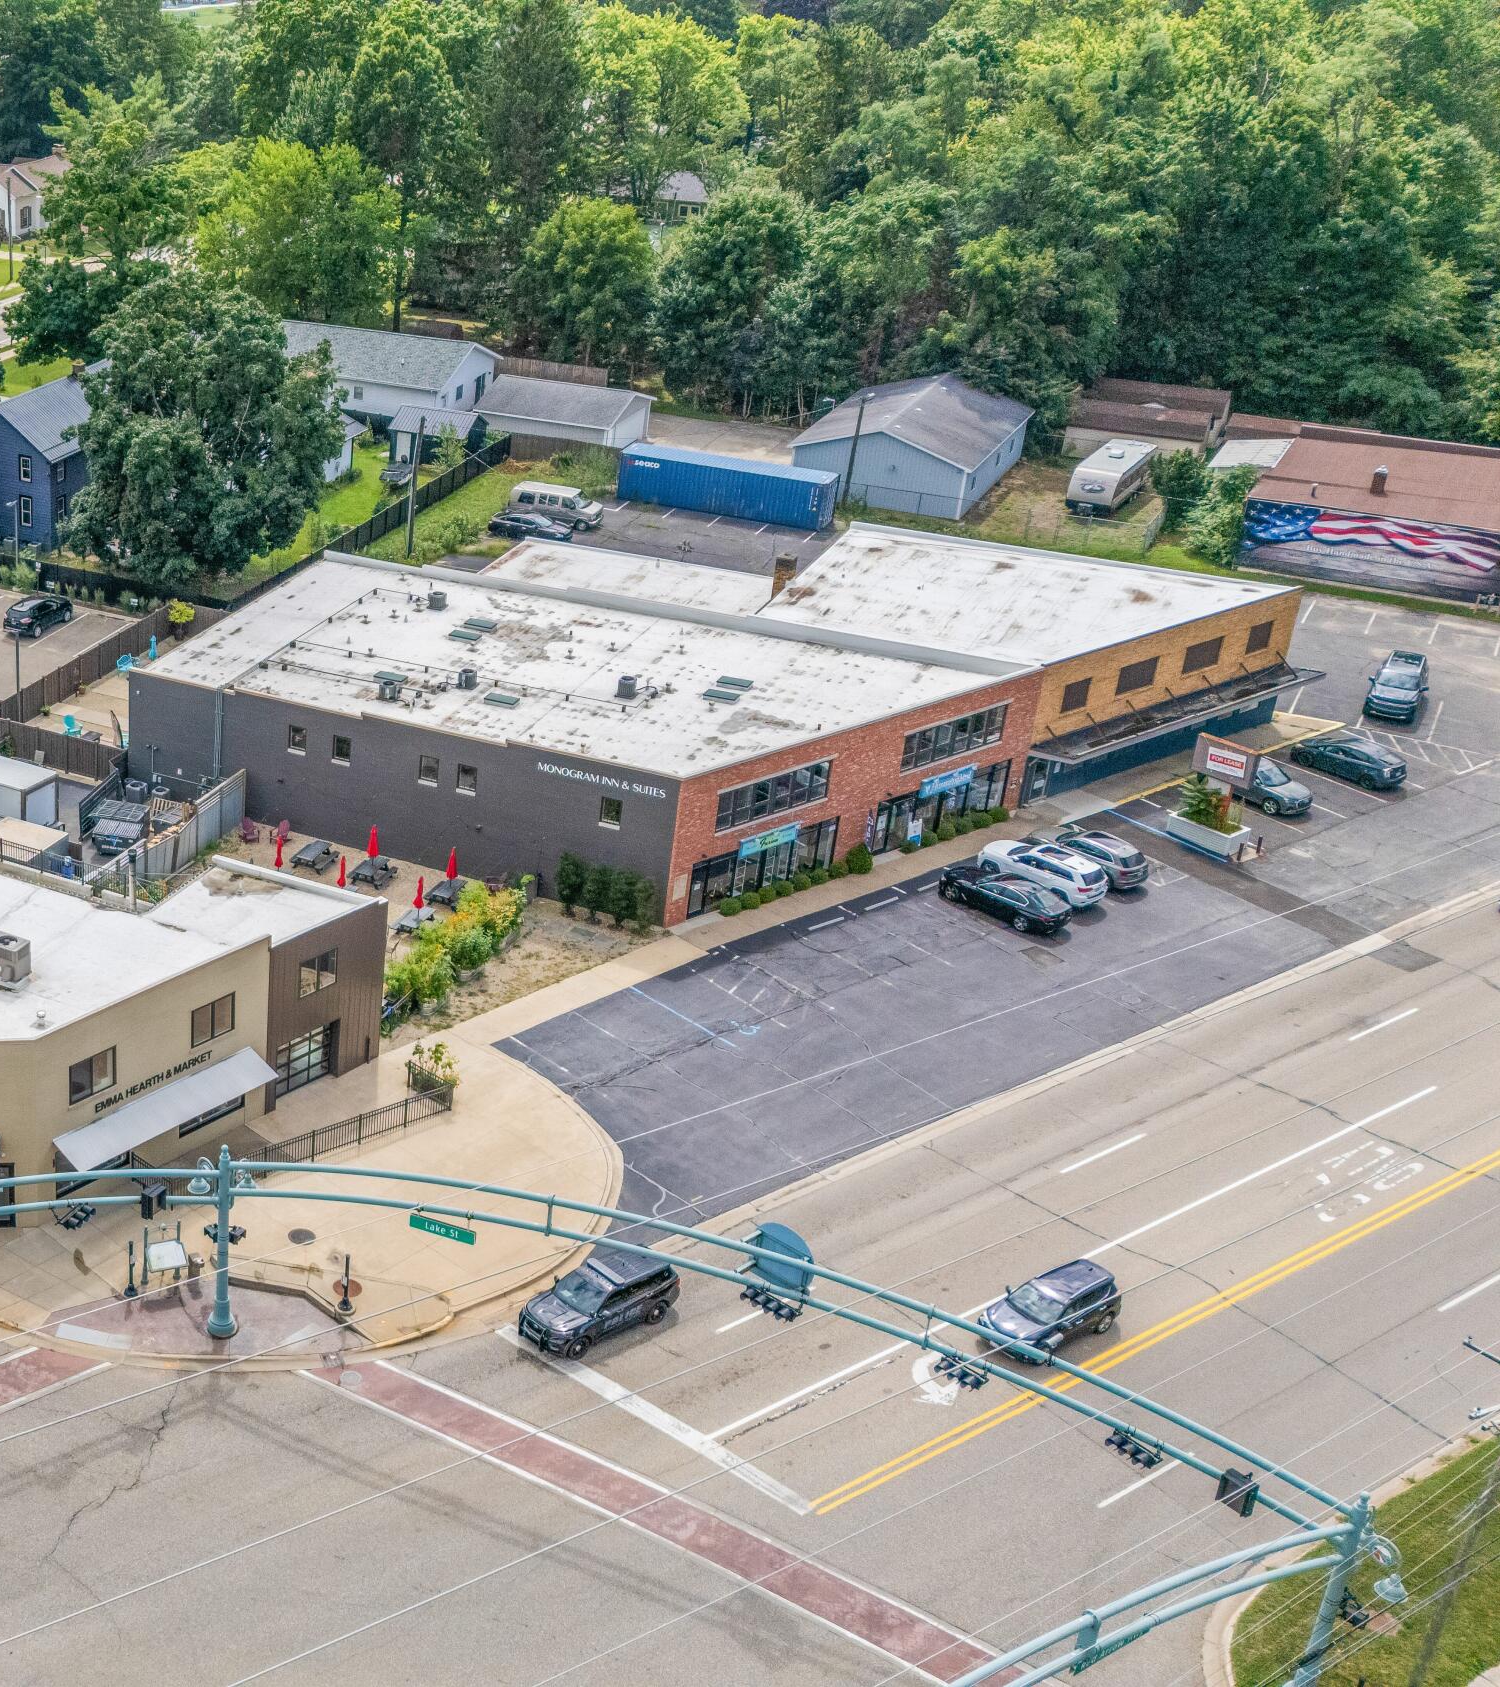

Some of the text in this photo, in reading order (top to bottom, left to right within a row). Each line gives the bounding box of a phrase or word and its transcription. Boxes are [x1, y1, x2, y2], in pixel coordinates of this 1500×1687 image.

[1325, 546, 1376, 561] Handmade
[1211, 755, 1243, 768] FOR LEASE
[537, 761, 667, 799] MONOGRAM INN & SUITES
[94, 1050, 213, 1114] EMMA HEARTH & MARKET
[425, 1221, 459, 1239] Lake St
